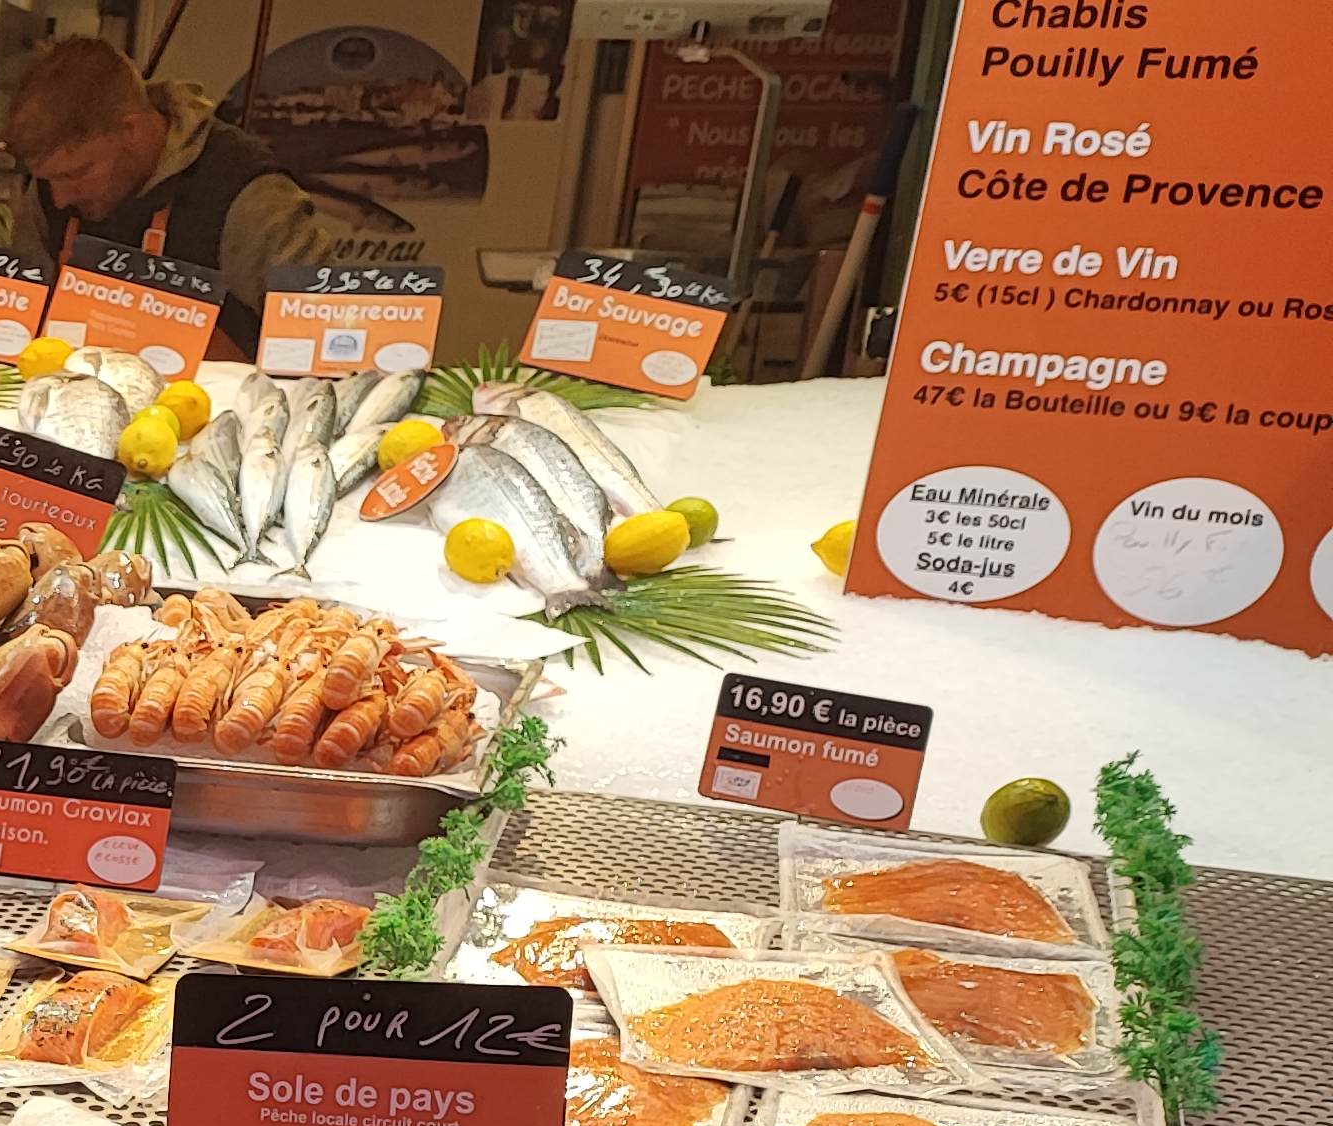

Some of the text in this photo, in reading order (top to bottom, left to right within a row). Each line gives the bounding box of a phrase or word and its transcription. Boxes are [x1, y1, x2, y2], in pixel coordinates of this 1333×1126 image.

[991, 0, 1149, 29] Chablis
[981, 47, 1259, 86] Pouilly Fumé
[967, 121, 1152, 157] Vin Rosé
[957, 169, 1325, 209] Côte de Provence
[942, 240, 1178, 279] Verre Vin
[61, 270, 134, 308] Dorade
[138, 293, 208, 328] Royale
[279, 298, 425, 325] Maquereaux
[552, 288, 705, 337] Bar Sauvage
[934, 283, 1229, 321] 5€ Chardonnay
[920, 341, 1168, 390] Champagne
[913, 386, 1215, 423] 47€ Bouteille 9€
[910, 484, 1050, 510] Eau Minérale
[1130, 500, 1265, 527] Vin du mois
[925, 510, 1026, 530] 3€ les 50cl
[928, 531, 1014, 552] 5€ litre
[916, 554, 1015, 578] Soda-jus
[949, 580, 974, 596] 4€
[730, 684, 922, 738] 16,90 pièce
[724, 724, 880, 767] Saumon fumé
[63, 797, 151, 827] Gravlax
[216, 995, 274, 1045] 2
[248, 1071, 475, 1119] Sole de pays
[260, 1109, 308, 1125] Pêche
